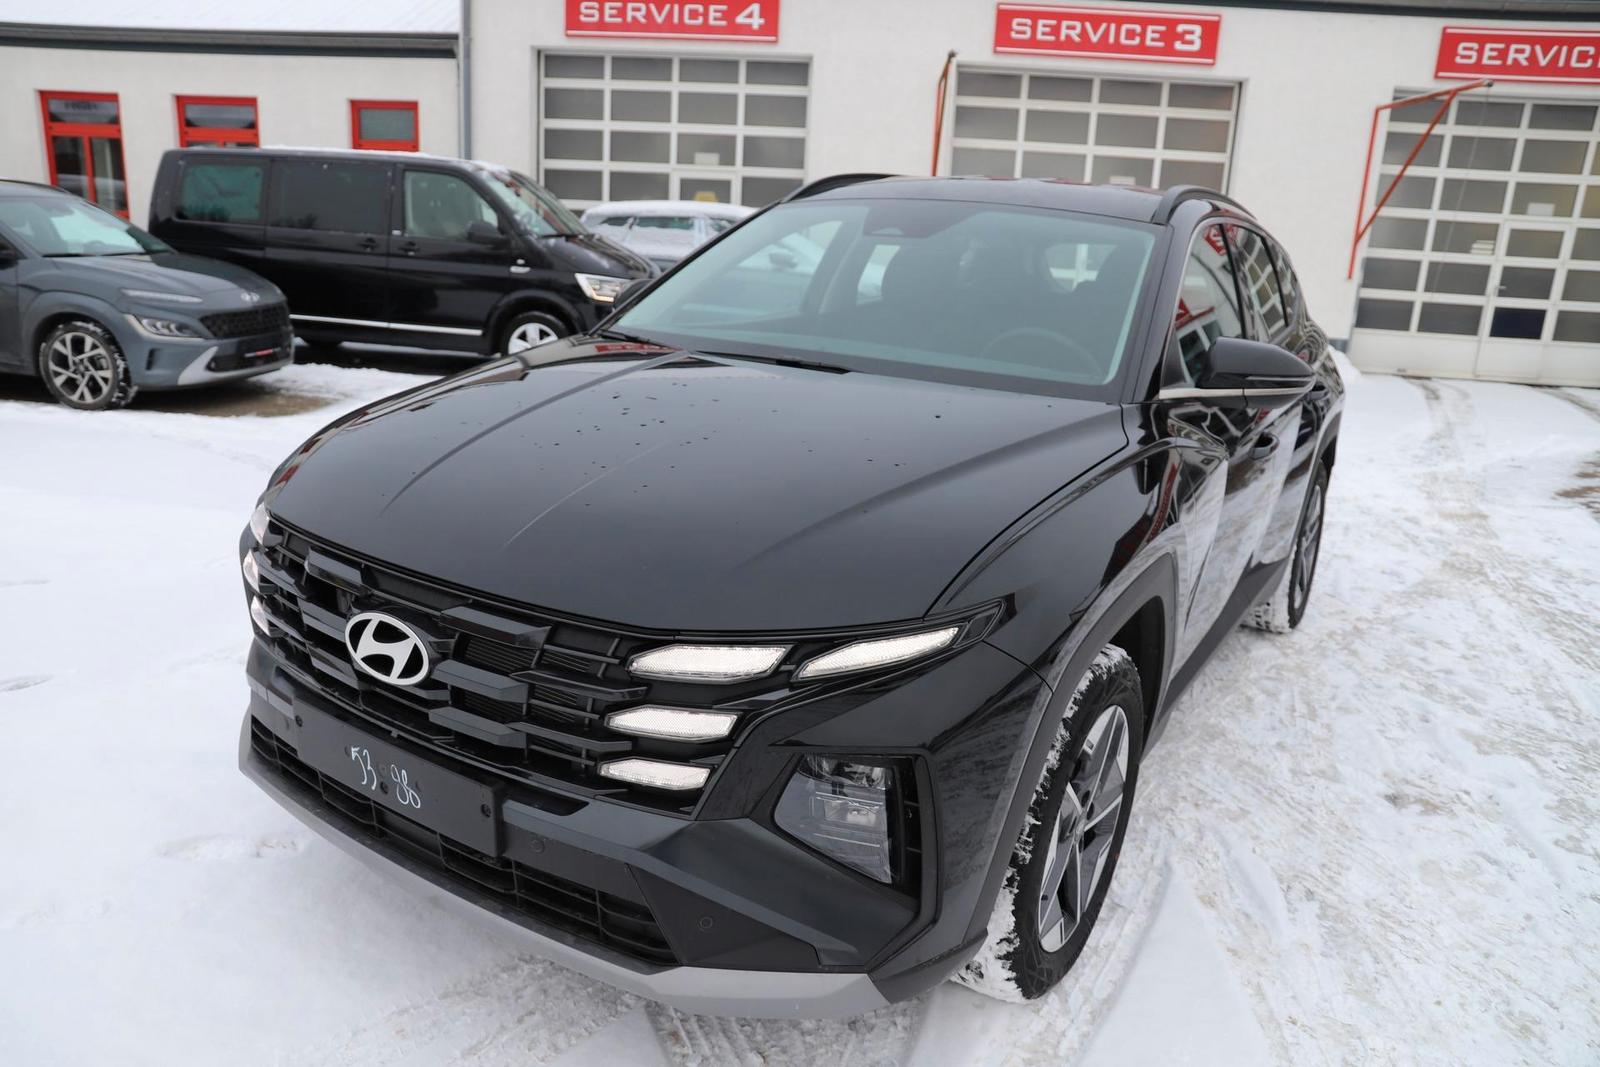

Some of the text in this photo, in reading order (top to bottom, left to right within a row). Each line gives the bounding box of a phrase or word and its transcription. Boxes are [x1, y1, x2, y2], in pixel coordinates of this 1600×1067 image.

[579, 2, 765, 30] SERVICE 4
[1010, 18, 1202, 51] SERVICE 3
[1454, 42, 1600, 68] SERVIC
